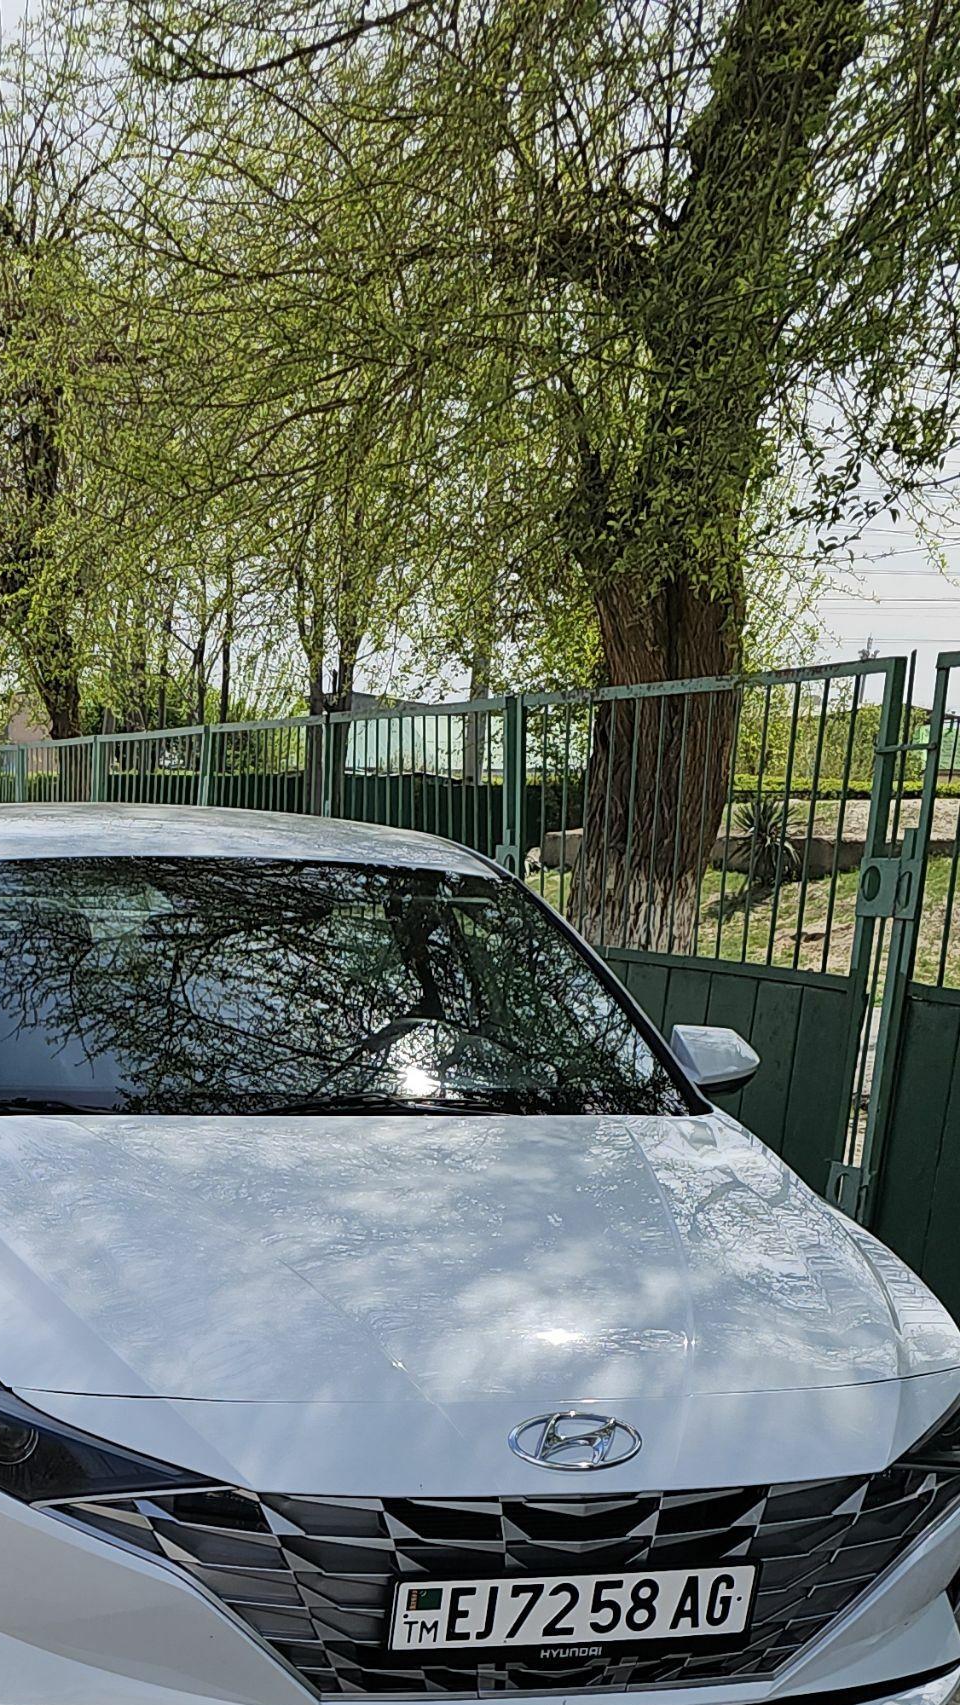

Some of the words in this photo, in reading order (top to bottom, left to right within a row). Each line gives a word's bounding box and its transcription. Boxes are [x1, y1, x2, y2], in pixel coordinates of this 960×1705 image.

[669, 1574, 735, 1630] AG
[403, 1620, 439, 1643] TM
[540, 1646, 603, 1659] HYUNDAI
